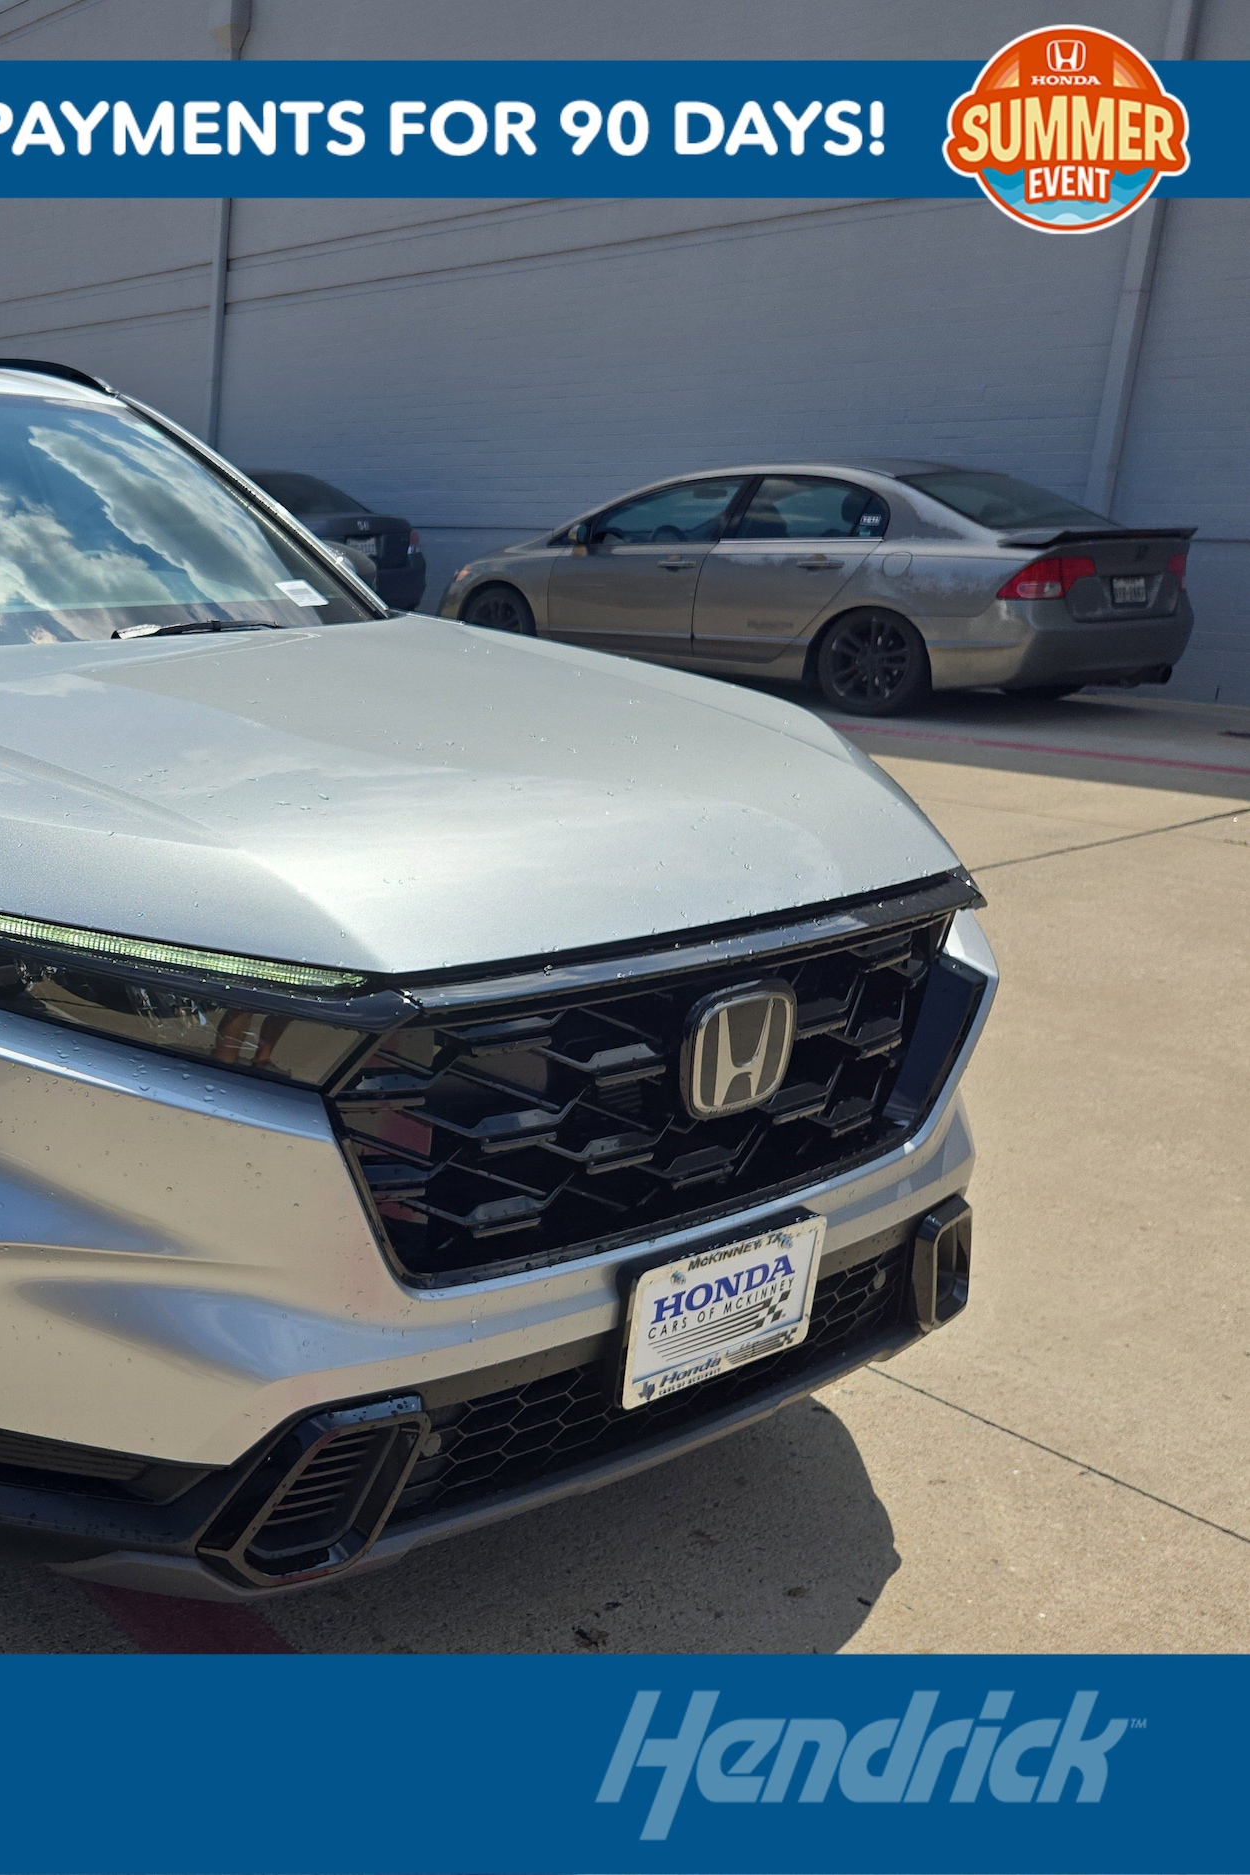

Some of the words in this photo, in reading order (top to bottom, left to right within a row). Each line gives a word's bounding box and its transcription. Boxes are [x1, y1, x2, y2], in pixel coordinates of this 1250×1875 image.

[648, 1316, 688, 1340] CARS
[697, 1307, 715, 1323] OF
[723, 1277, 795, 1315] MCKINNEY
[650, 1254, 795, 1325] HONDA
[659, 1356, 722, 1387] Honda
